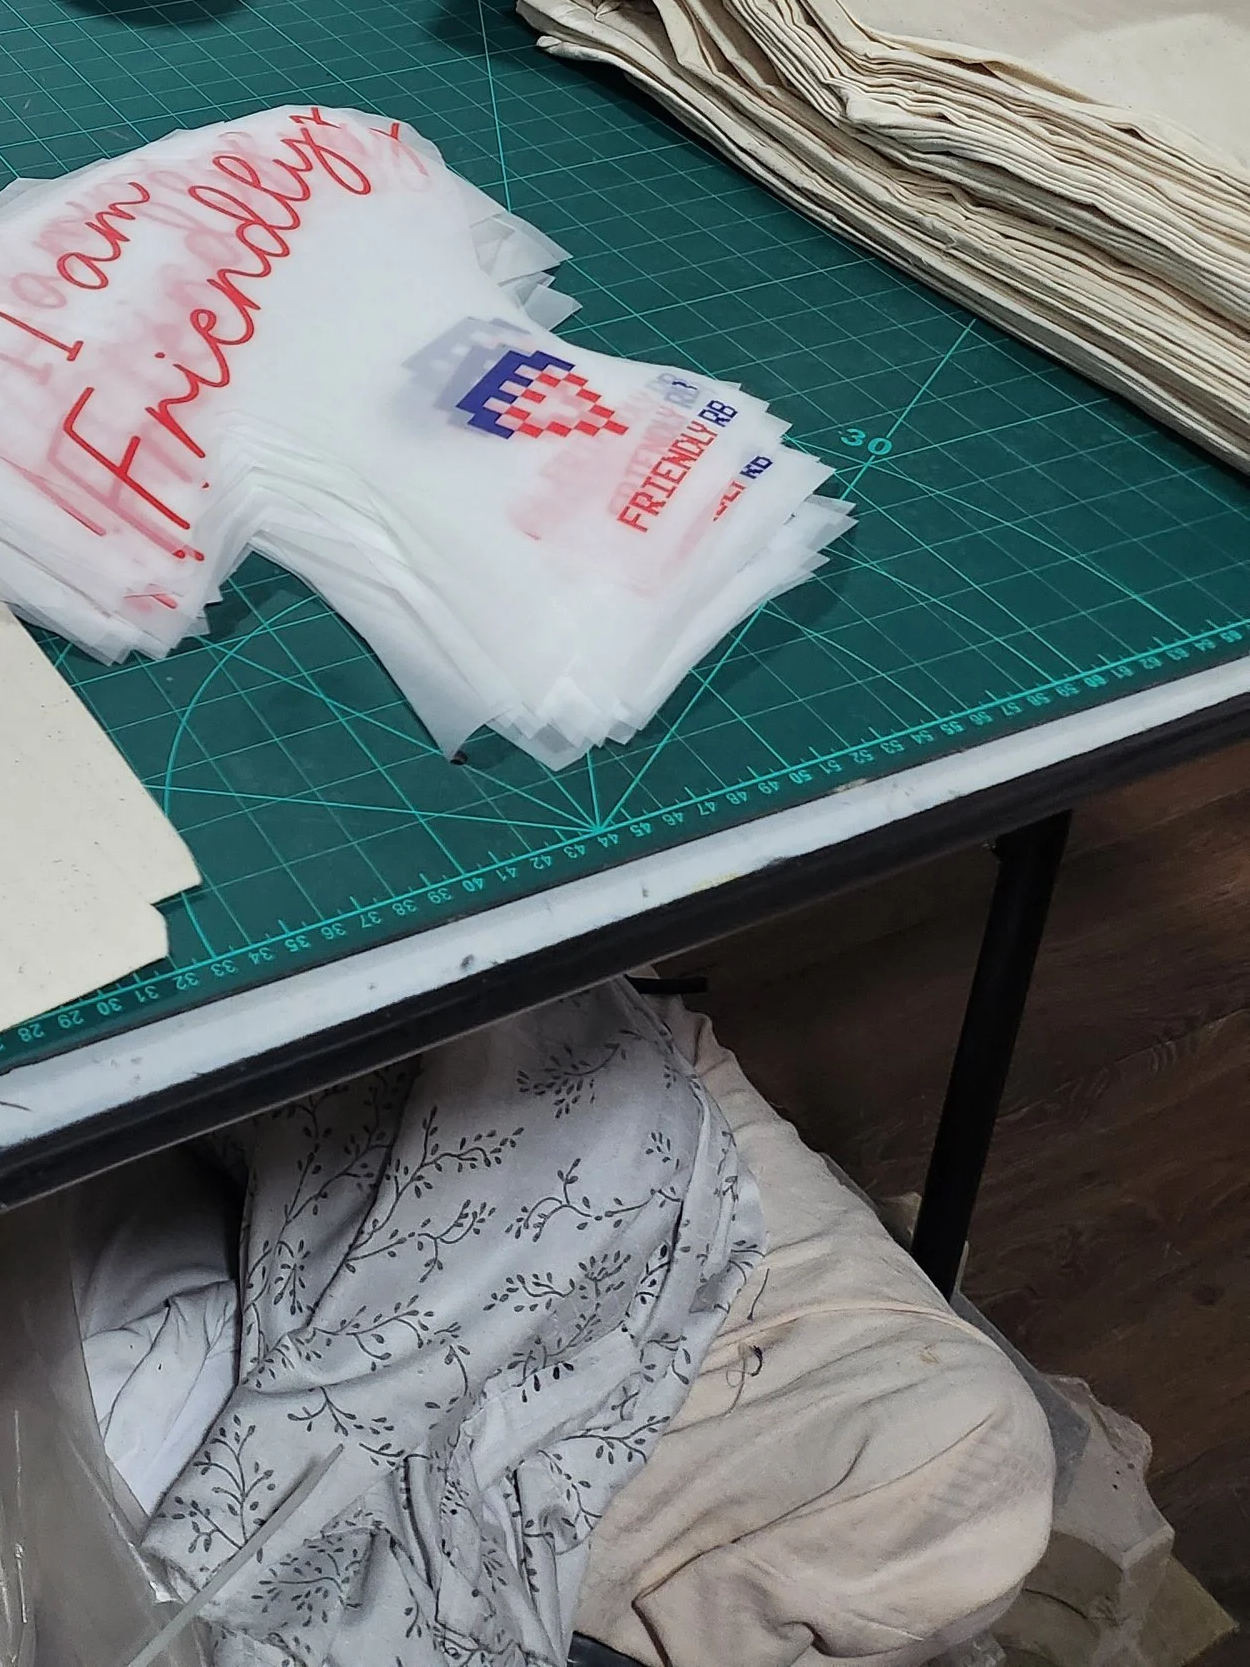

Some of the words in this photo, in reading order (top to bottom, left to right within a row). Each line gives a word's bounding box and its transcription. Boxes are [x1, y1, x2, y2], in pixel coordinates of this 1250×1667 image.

[57, 182, 151, 290] am
[62, 120, 372, 530] Friendly
[840, 428, 893, 455] 30
[616, 419, 719, 534] FRIENDLY
[697, 398, 739, 428] RB
[1138, 656, 1163, 670] 62
[1111, 665, 1135, 679] 61
[1083, 674, 1109, 688] 60
[1000, 702, 1023, 717] 57
[939, 721, 966, 735] 55
[909, 730, 935, 745] 54
[879, 740, 906, 754] 53
[849, 750, 875, 764] 52
[819, 760, 844, 775] 51
[788, 770, 814, 784] 50
[757, 781, 781, 795] 49
[725, 791, 748, 805] 48
[696, 801, 718, 816] 47
[661, 812, 685, 826] 46
[629, 822, 653, 837] 45
[597, 833, 620, 848] 44
[562, 844, 586, 859] 43
[528, 855, 553, 870] 42
[495, 866, 518, 882] 41
[461, 877, 486, 893] 40
[427, 887, 454, 904] 39
[392, 899, 418, 916] 38
[358, 911, 383, 929] 37
[320, 922, 347, 940] 36
[284, 935, 312, 952] 35
[248, 947, 276, 965] 34
[210, 960, 239, 977] 33
[172, 972, 200, 990] 32
[134, 985, 160, 1003] 31
[96, 998, 124, 1016] 30
[57, 1010, 85, 1029] 29
[17, 1023, 46, 1043] 28
